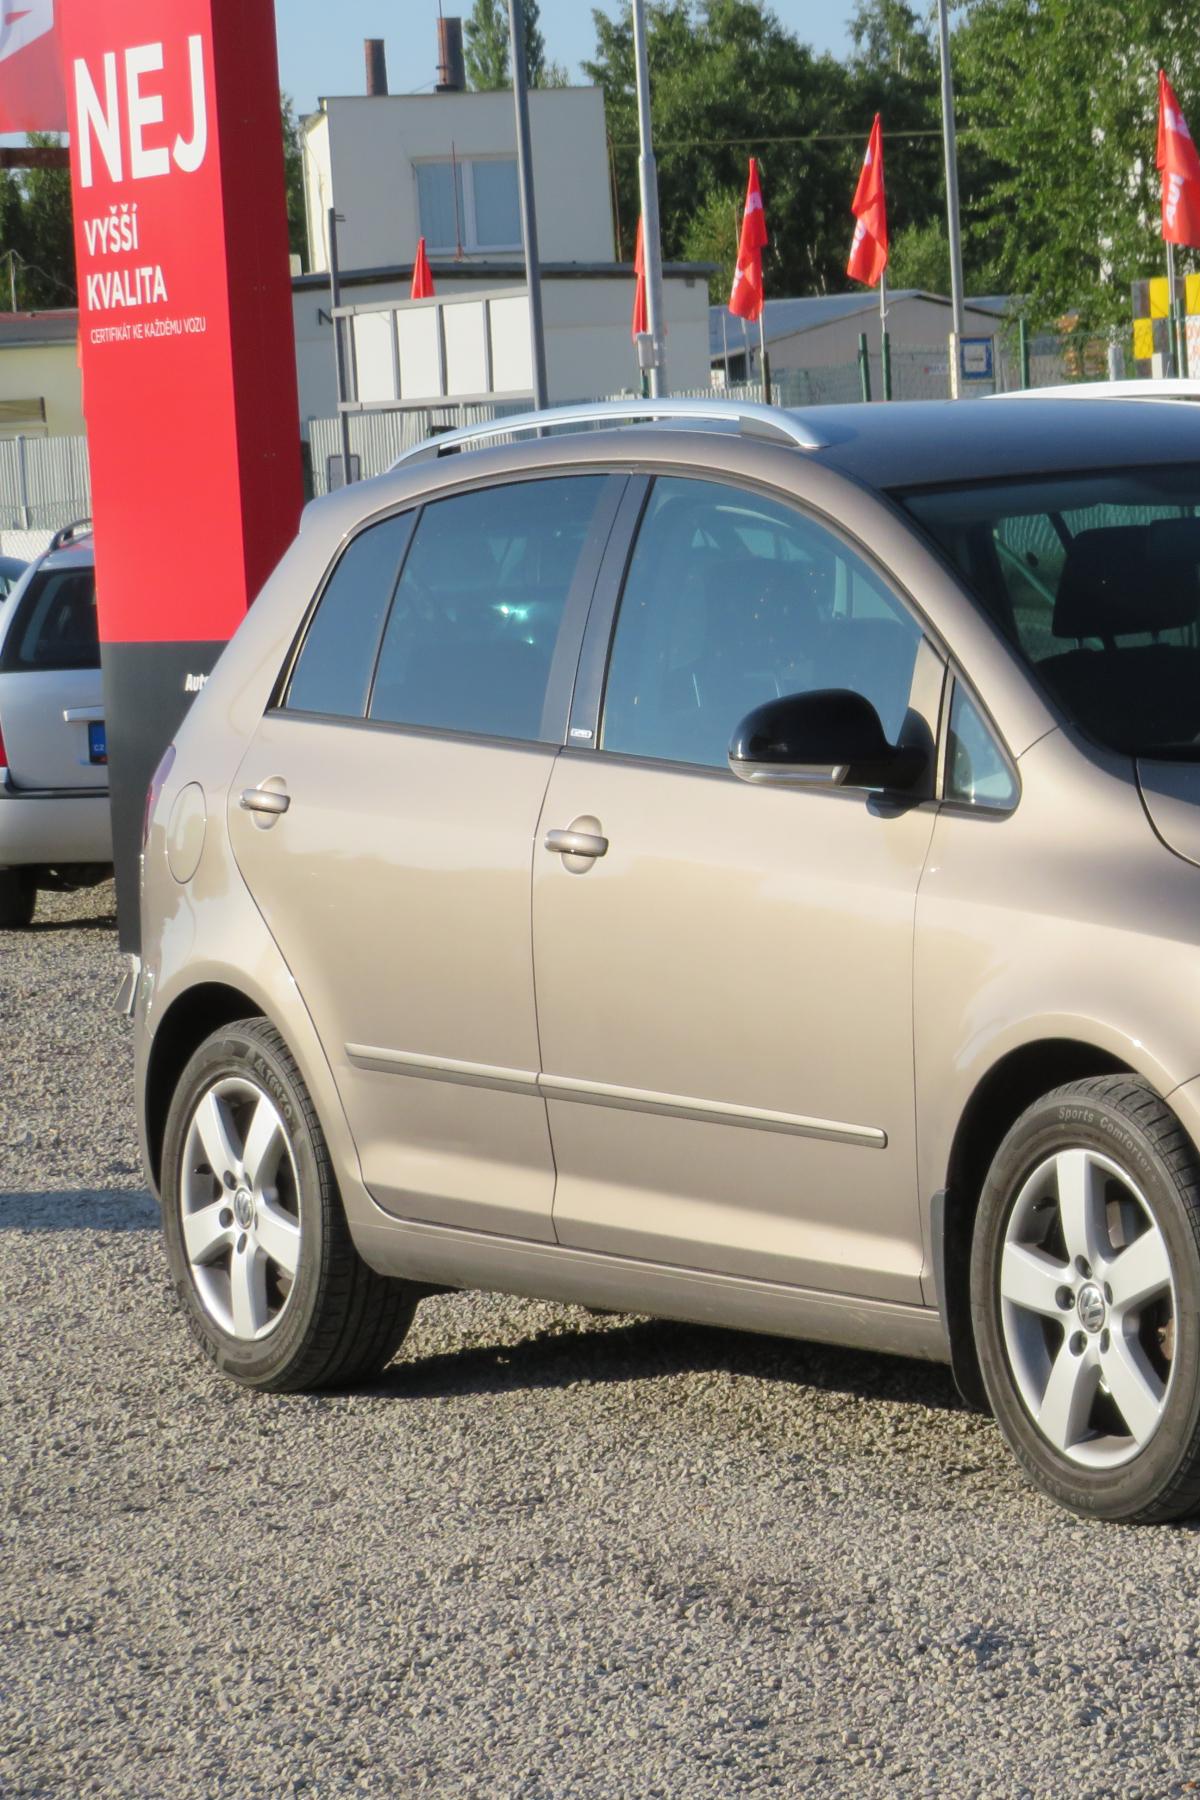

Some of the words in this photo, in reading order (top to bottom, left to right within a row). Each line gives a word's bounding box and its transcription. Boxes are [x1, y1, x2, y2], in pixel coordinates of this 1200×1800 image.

[73, 34, 207, 188] NEJ
[84, 202, 139, 256] VYŠŠÍ
[86, 265, 168, 311] KVALITA
[90, 322, 131, 344] CERTIFIKÁT
[133, 323, 143, 339] KE
[144, 317, 182, 338] KAŽDÉMU
[183, 316, 206, 333] VOZU
[1058, 1106, 1095, 1122] Sports
[1099, 1115, 1152, 1173] Comforter
